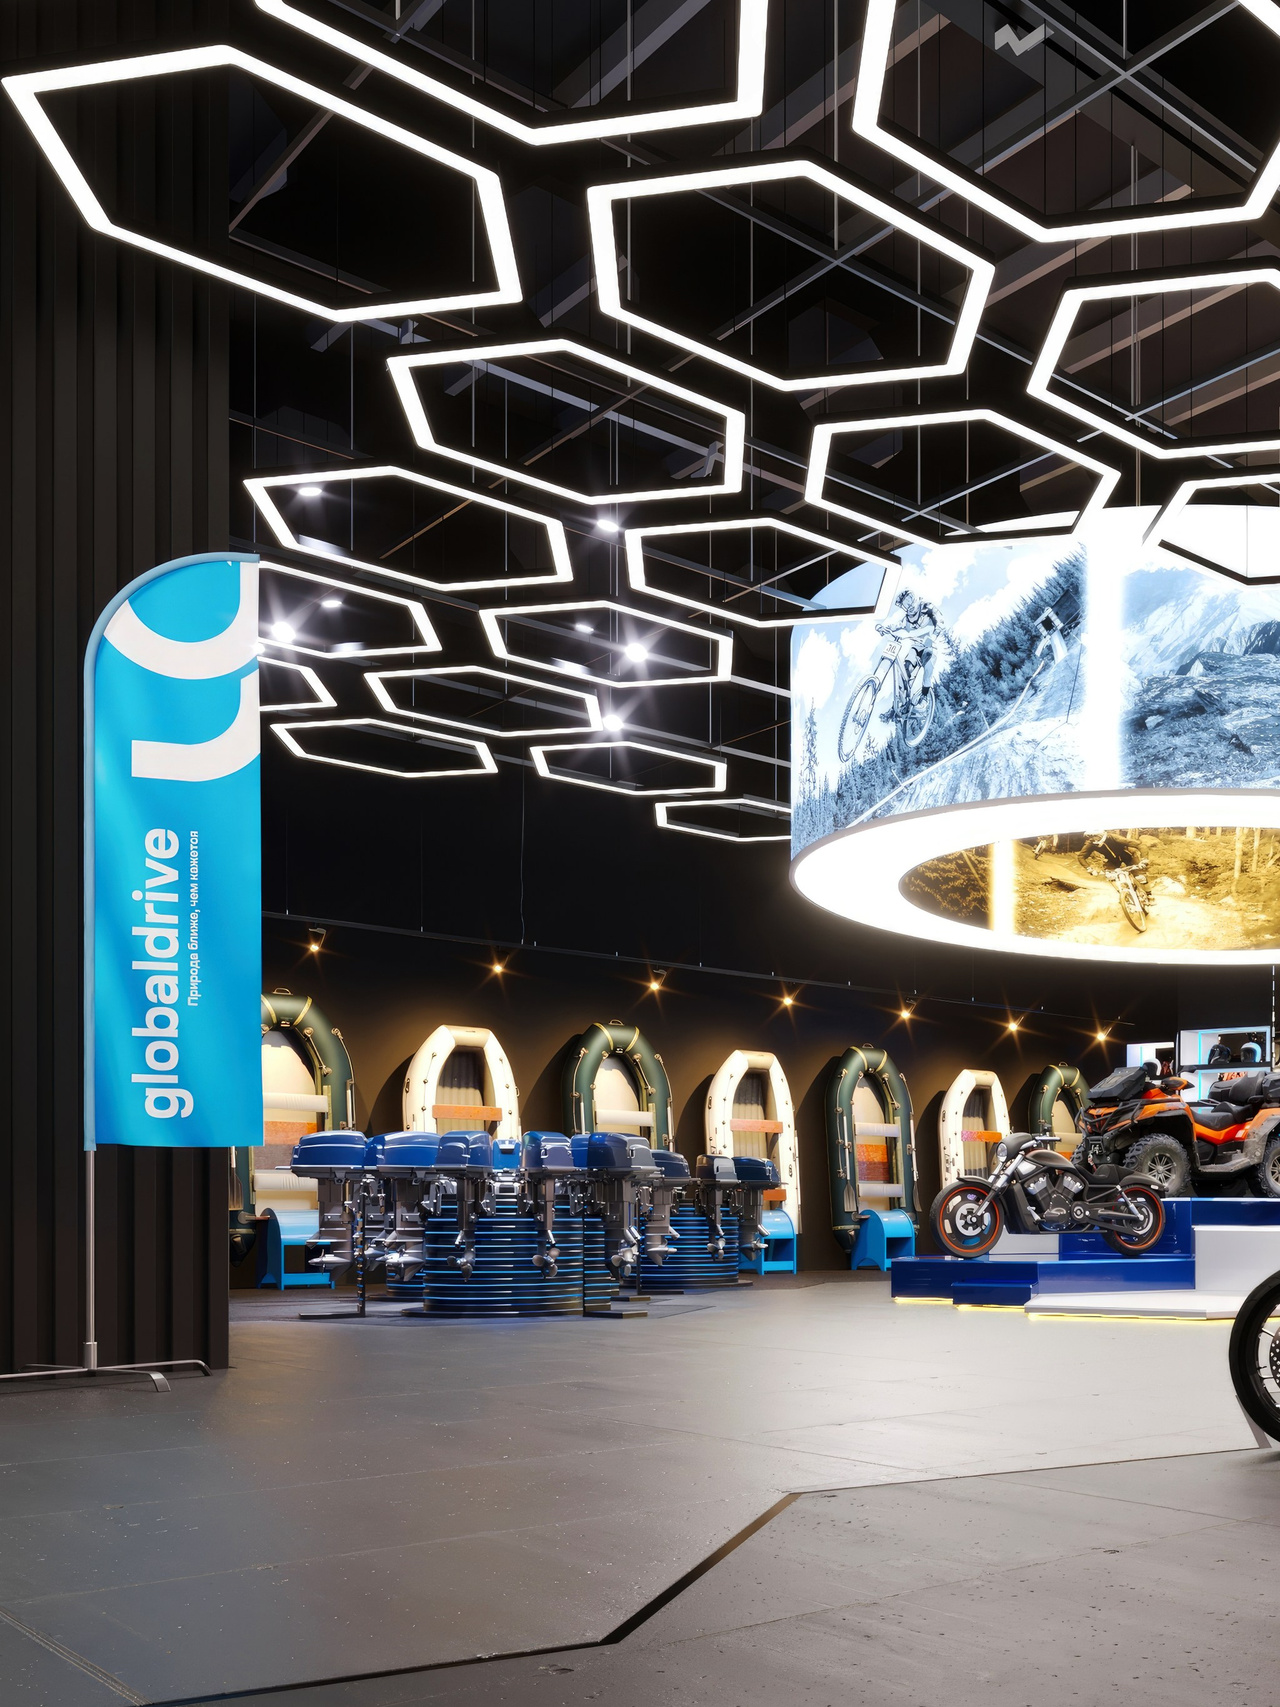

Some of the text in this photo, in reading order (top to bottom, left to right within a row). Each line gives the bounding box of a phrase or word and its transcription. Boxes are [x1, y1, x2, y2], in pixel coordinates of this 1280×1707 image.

[189, 883, 199, 907] чем
[131, 828, 194, 1119] globaldrive
[187, 953, 202, 1007] Природа
